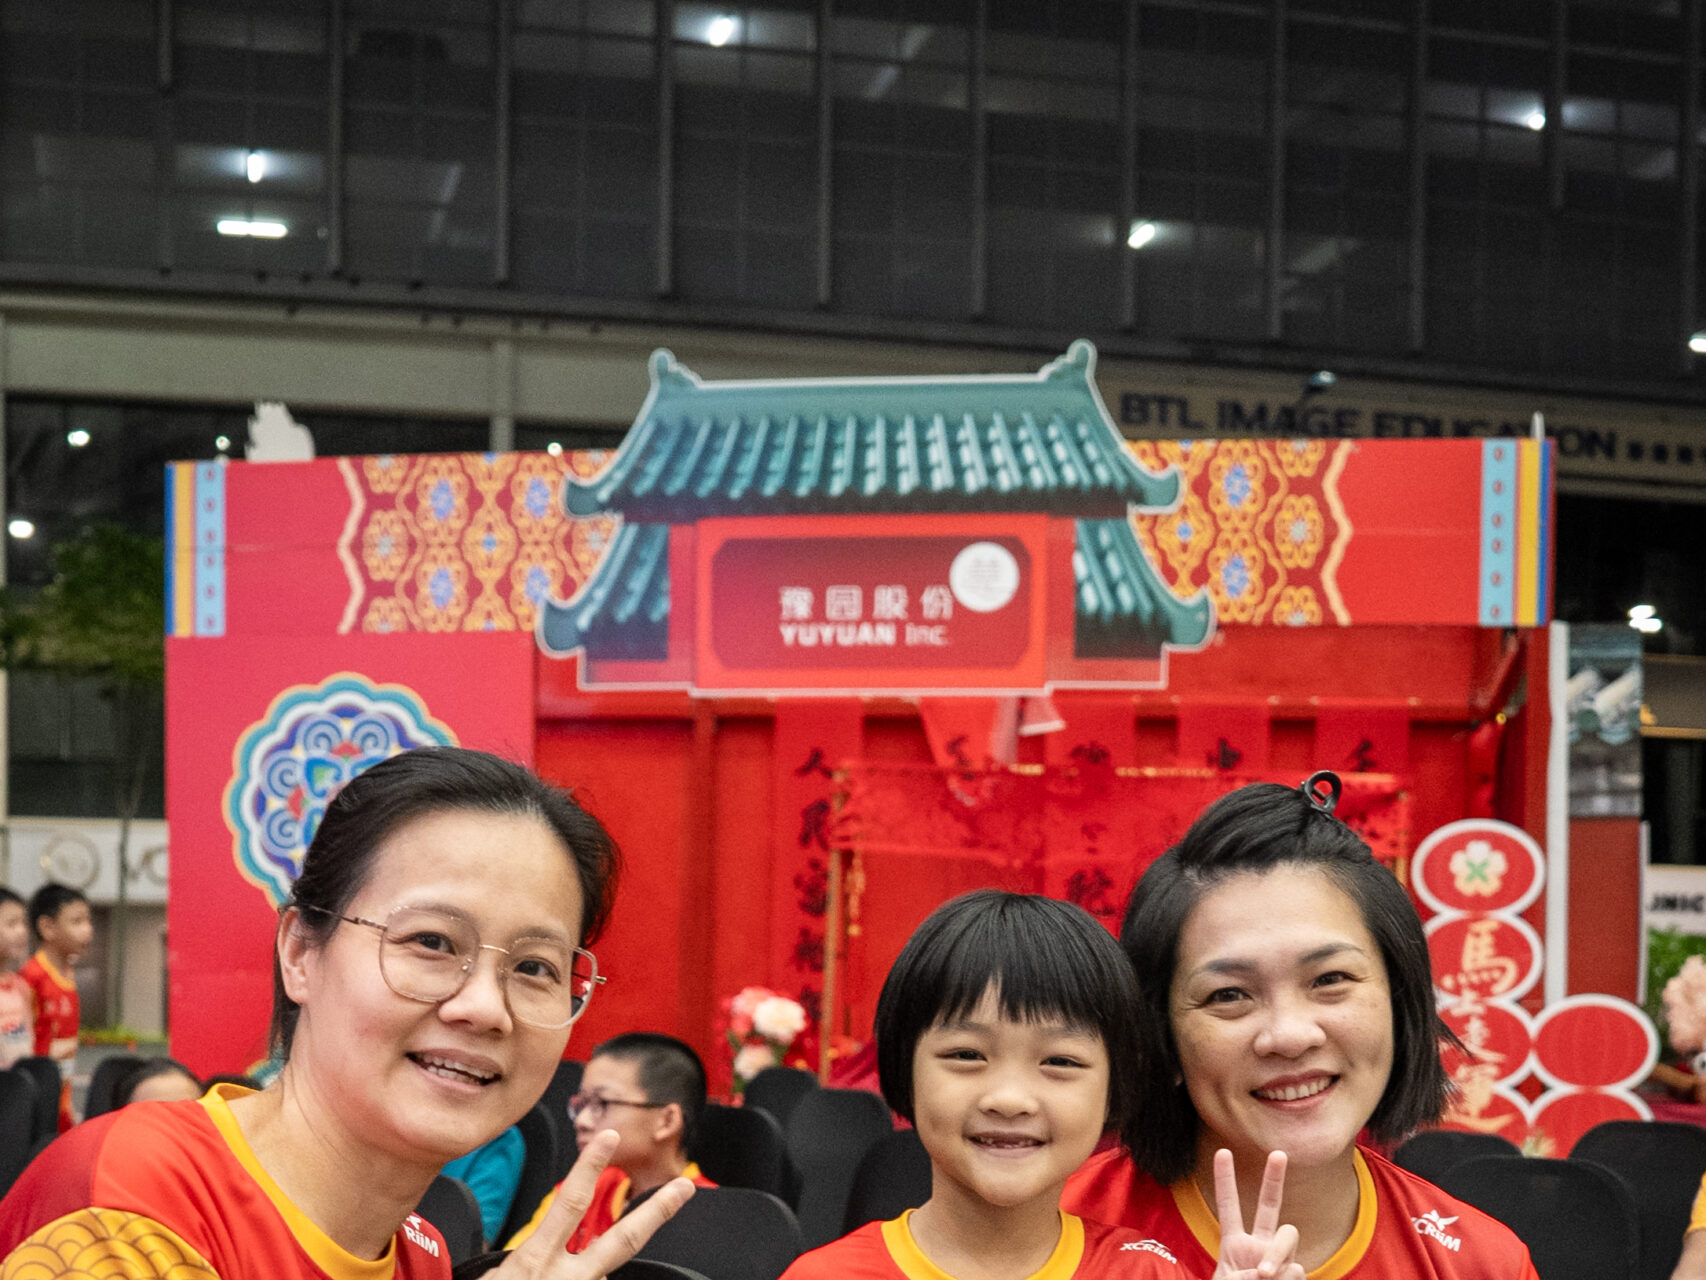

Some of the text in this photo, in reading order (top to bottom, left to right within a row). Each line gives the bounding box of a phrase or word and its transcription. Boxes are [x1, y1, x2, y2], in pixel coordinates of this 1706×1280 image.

[1120, 392, 1203, 430] BTL
[1217, 399, 1361, 438] IMAGE
[779, 622, 897, 646] YUYUAN
